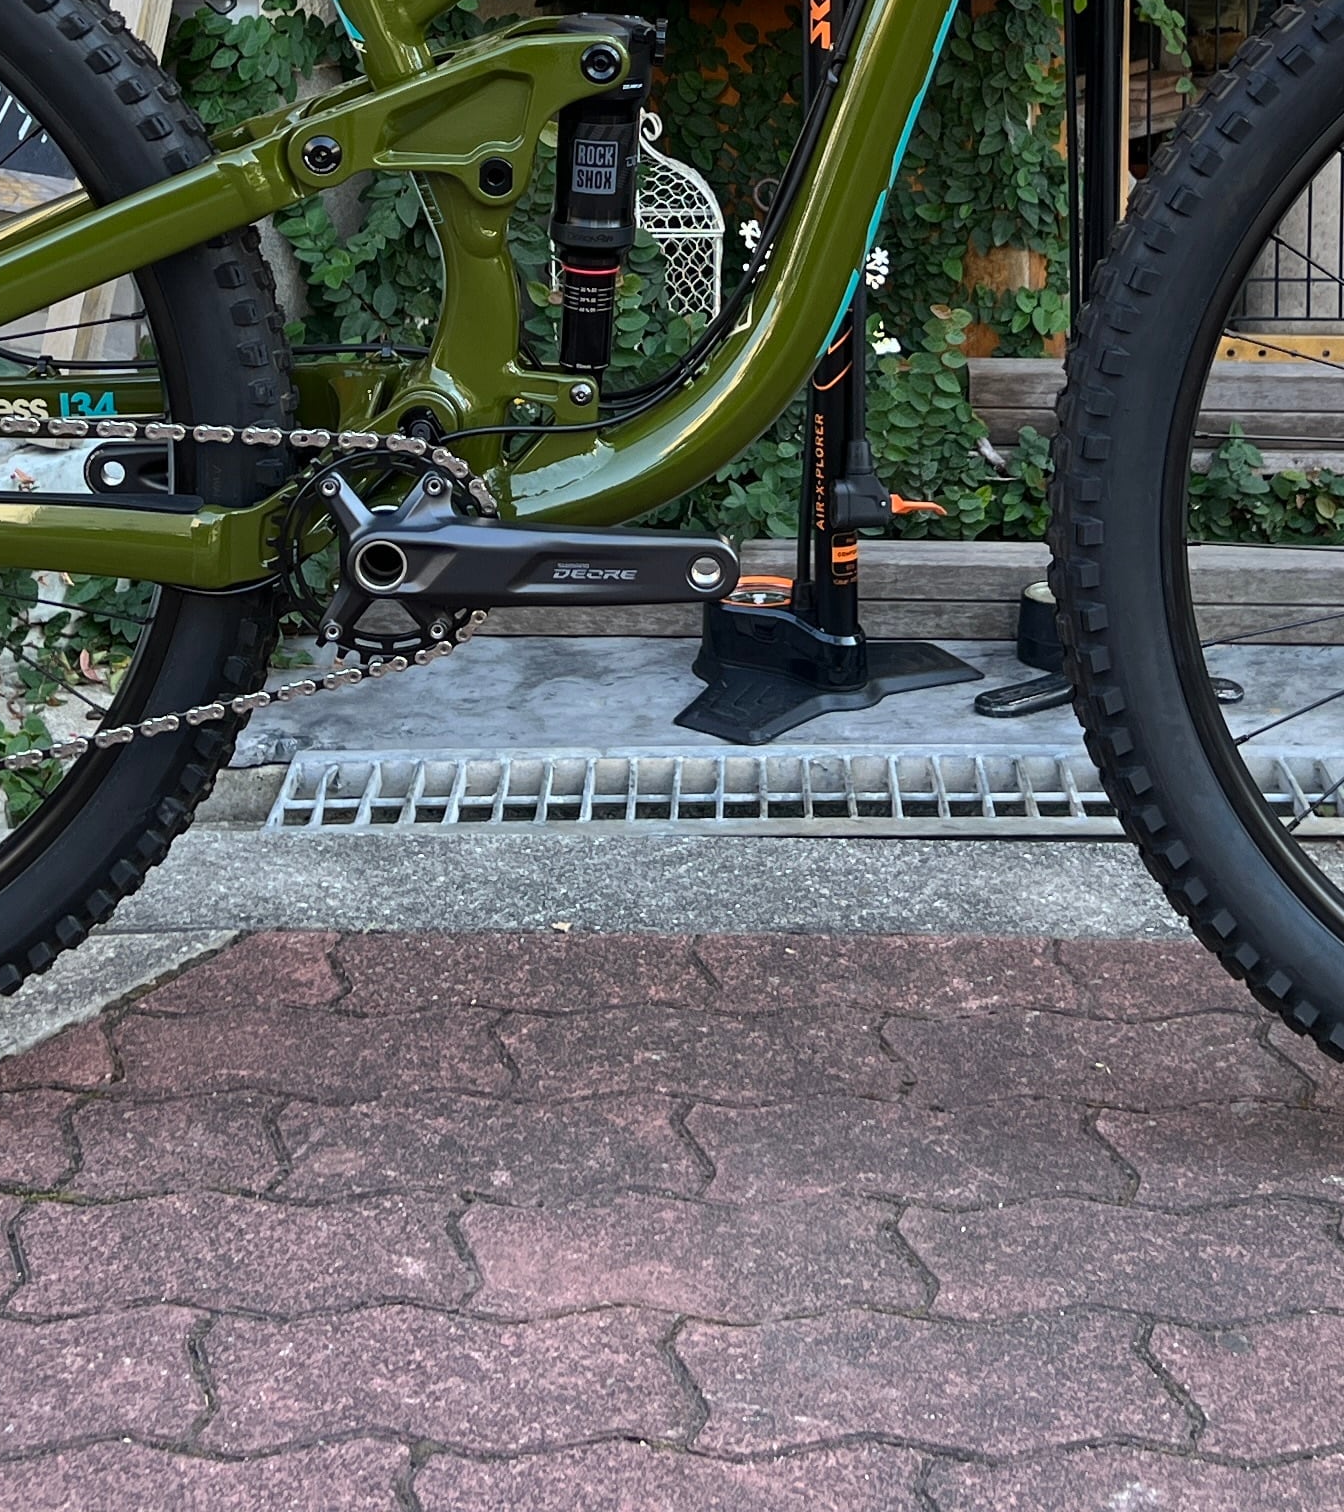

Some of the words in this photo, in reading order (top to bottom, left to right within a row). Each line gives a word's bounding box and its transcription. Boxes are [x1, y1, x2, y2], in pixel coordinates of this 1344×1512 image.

[577, 144, 613, 166] ROCK
[577, 169, 613, 190] SHOX
[59, 391, 119, 418] 134
[814, 413, 825, 531] AIR-X-PLORER
[553, 568, 638, 580] DEORE
